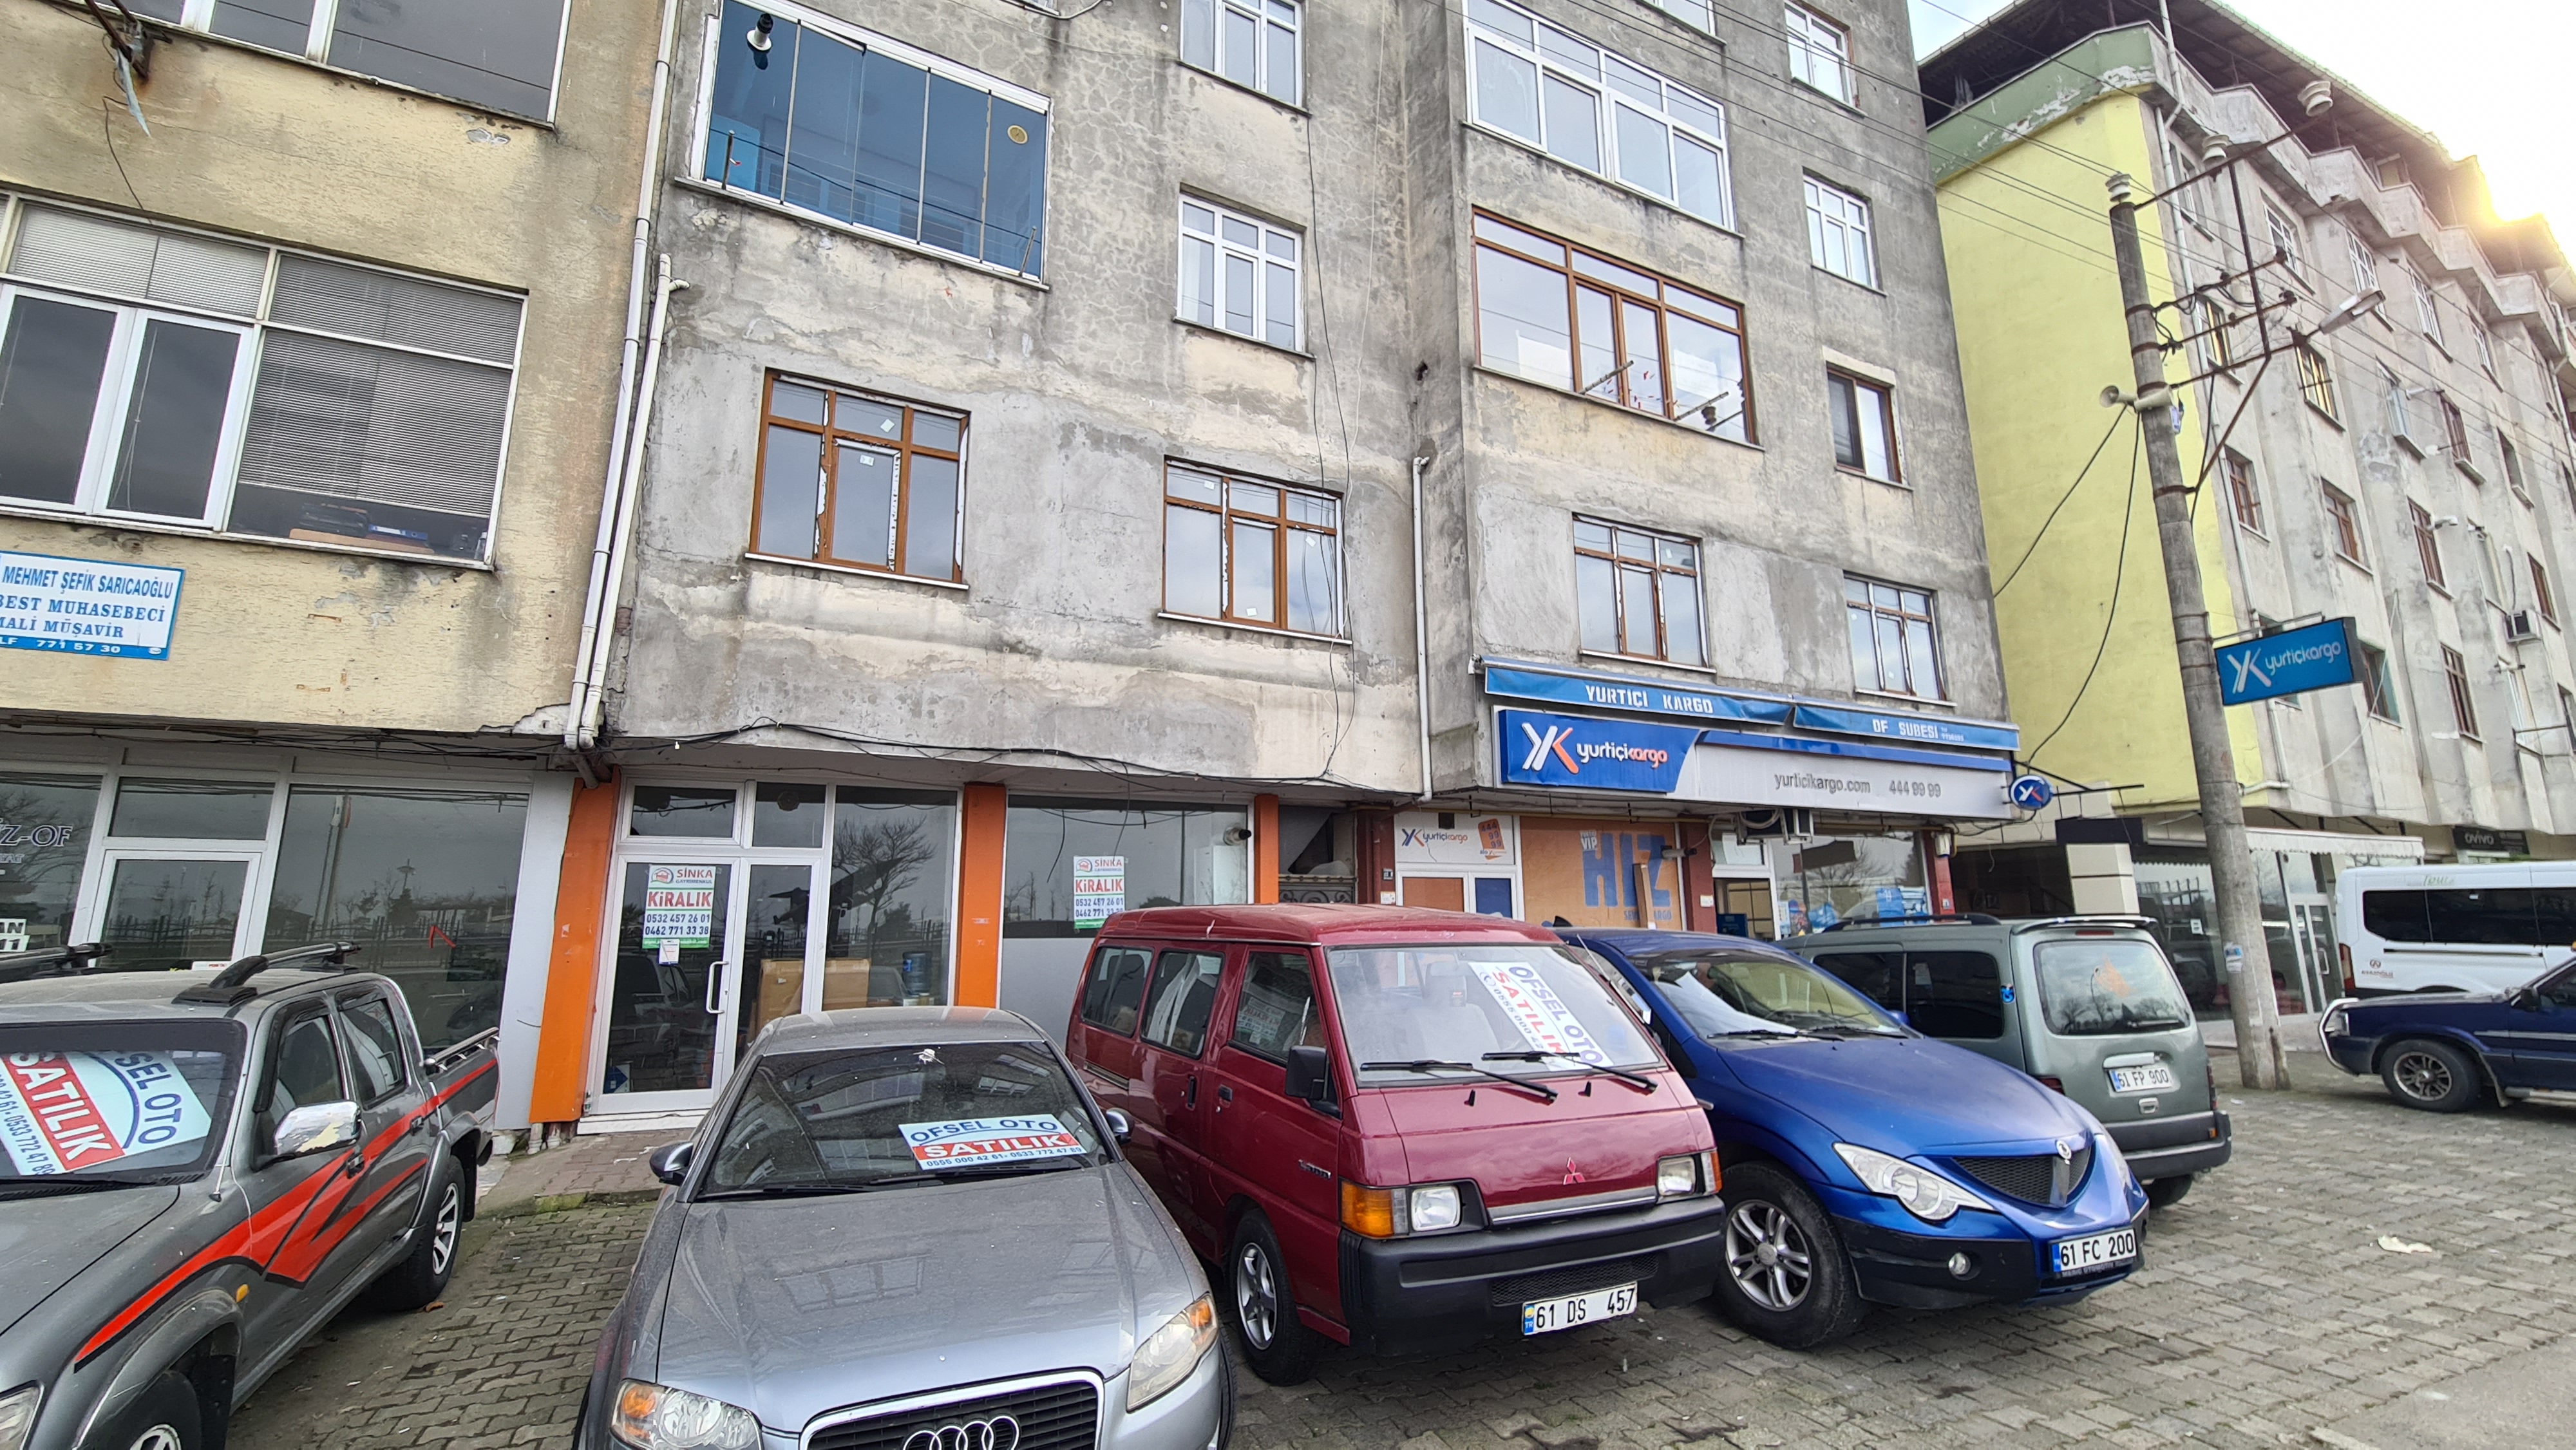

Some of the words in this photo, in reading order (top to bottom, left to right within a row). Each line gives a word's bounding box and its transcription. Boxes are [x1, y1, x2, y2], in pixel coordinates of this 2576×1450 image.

[3, 566, 58, 588] MEHMET
[61, 569, 96, 594] ŞEFİK
[98, 575, 173, 599] SARICAOĞLU
[48, 599, 165, 622] MUHASEBECİ
[43, 618, 124, 637] MÜŞAVİR
[37, 639, 66, 649] 771
[73, 643, 95, 652] 57
[100, 645, 120, 654] 30
[1663, 694, 1714, 714] KARGO
[1873, 719, 1888, 733] OF
[1889, 780, 1909, 795] 444
[1911, 782, 1926, 796] 99
[1928, 783, 1941, 798] 99
[1481, 821, 1497, 833] 444
[1488, 830, 1499, 840] 99
[1490, 839, 1502, 849] 99
[1580, 837, 1597, 849] VIP
[1095, 858, 1122, 867] SİNKA
[676, 867, 713, 878] SİNKA
[1075, 898, 1092, 907] 0532
[1106, 898, 1115, 906] 26
[647, 914, 668, 923] 0532
[670, 914, 686, 923] 457
[688, 914, 698, 923] 26
[700, 914, 710, 923] 01
[1075, 909, 1091, 917] 0462
[1093, 909, 1104, 917] 771
[645, 926, 666, 935] 0462
[668, 926, 683, 935] 771
[687, 926, 697, 935] 33
[699, 926, 709, 935] 38
[1492, 971, 1567, 1053] SATILIK
[1493, 988, 1515, 1013] 0555
[1514, 1015, 1531, 1034] 000
[1508, 966, 1567, 1021] OFSEL
[1564, 1025, 1604, 1063] OTO
[2117, 1072, 2130, 1088] 61
[2132, 1071, 2145, 1086] FP
[2148, 1069, 2169, 1084] 900
[4, 1115, 33, 1136] 0533
[138, 1093, 182, 1144] OTO
[911, 1121, 991, 1142] OFSEL
[999, 1120, 1058, 1130] OTO
[15, 1135, 42, 1153] 772
[924, 1135, 1068, 1158] SATILIK
[26, 1153, 49, 1163] 47
[2061, 1243, 2076, 1266] 61
[2082, 1239, 2101, 1263] FC
[2108, 1232, 2134, 1257] 200
[1536, 1303, 1555, 1328] 61
[1567, 1298, 1586, 1324] DS
[1607, 1288, 1636, 1314] 457
